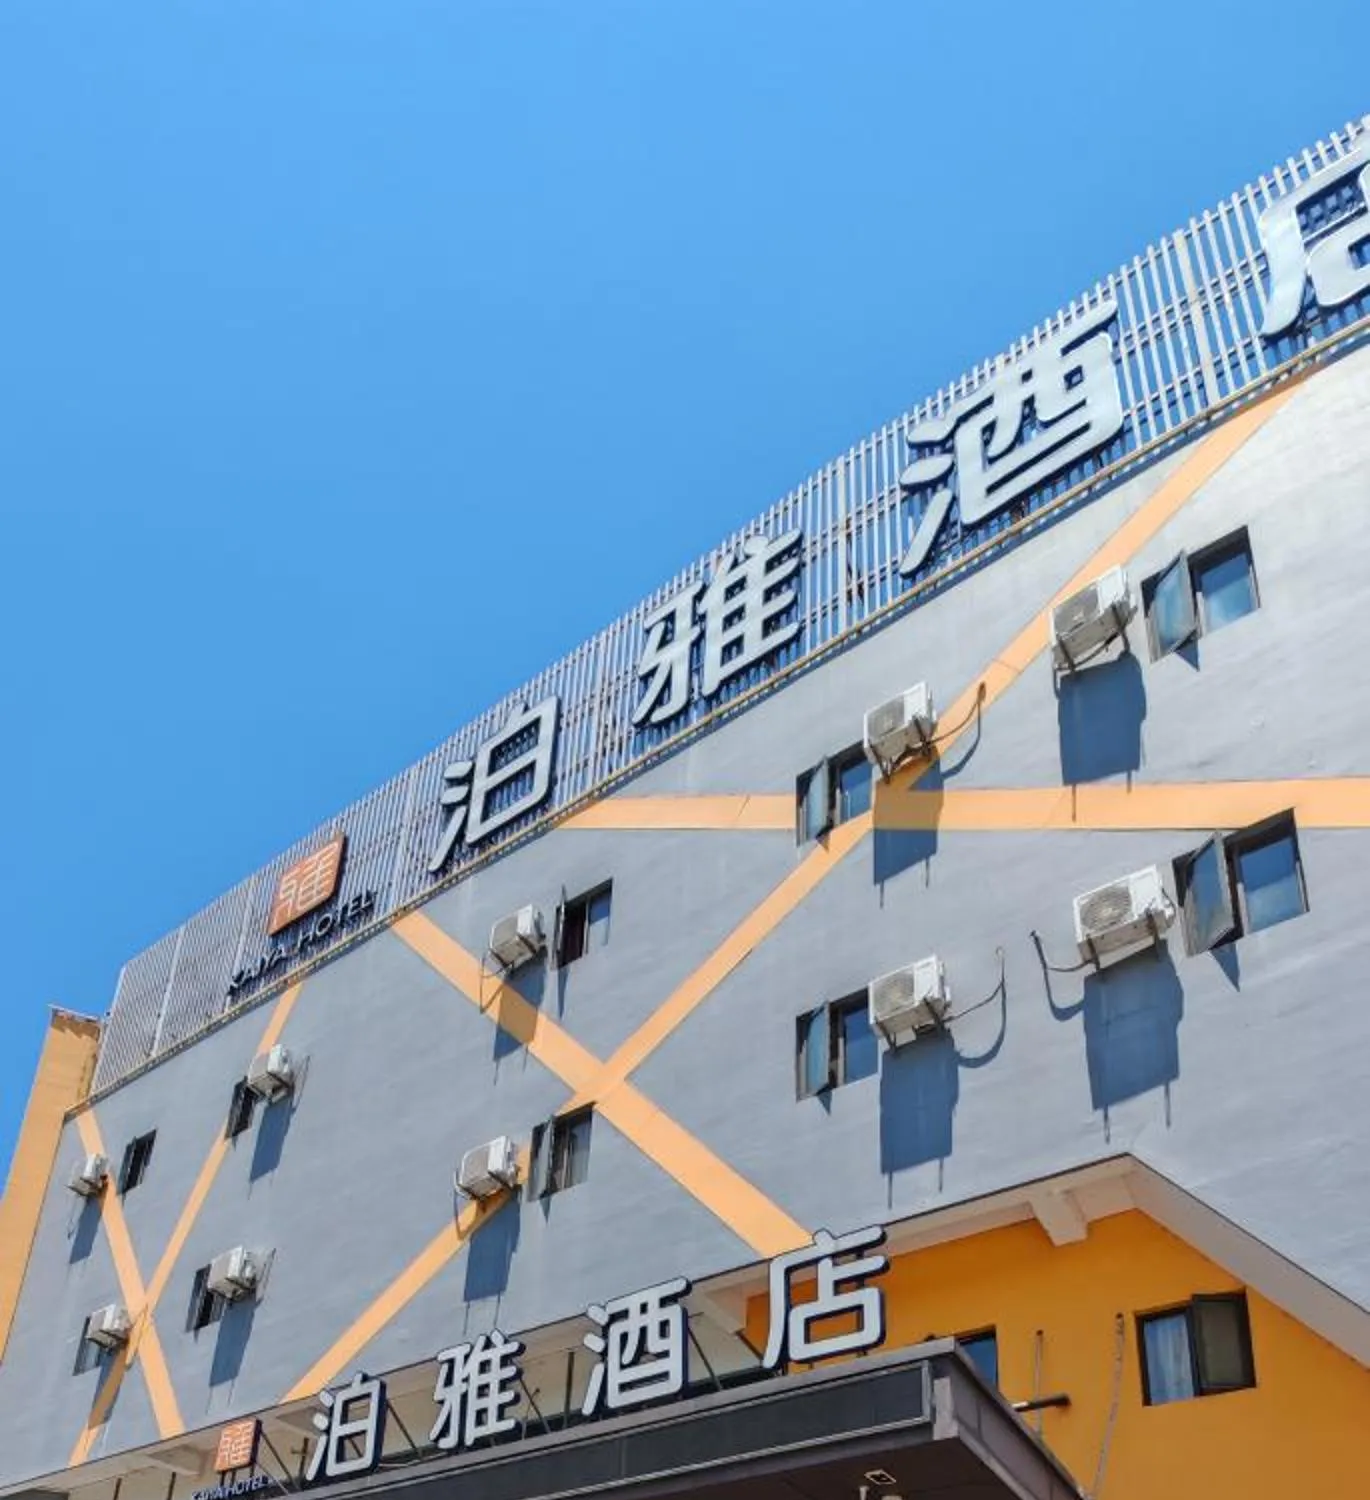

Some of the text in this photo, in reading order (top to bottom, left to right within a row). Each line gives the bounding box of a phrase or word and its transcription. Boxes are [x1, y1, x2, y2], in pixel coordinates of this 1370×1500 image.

[298, 890, 375, 949] HOTEL
[305, 1226, 889, 1482] 泊雅酒店
[225, 1476, 266, 1498] HOTEL
